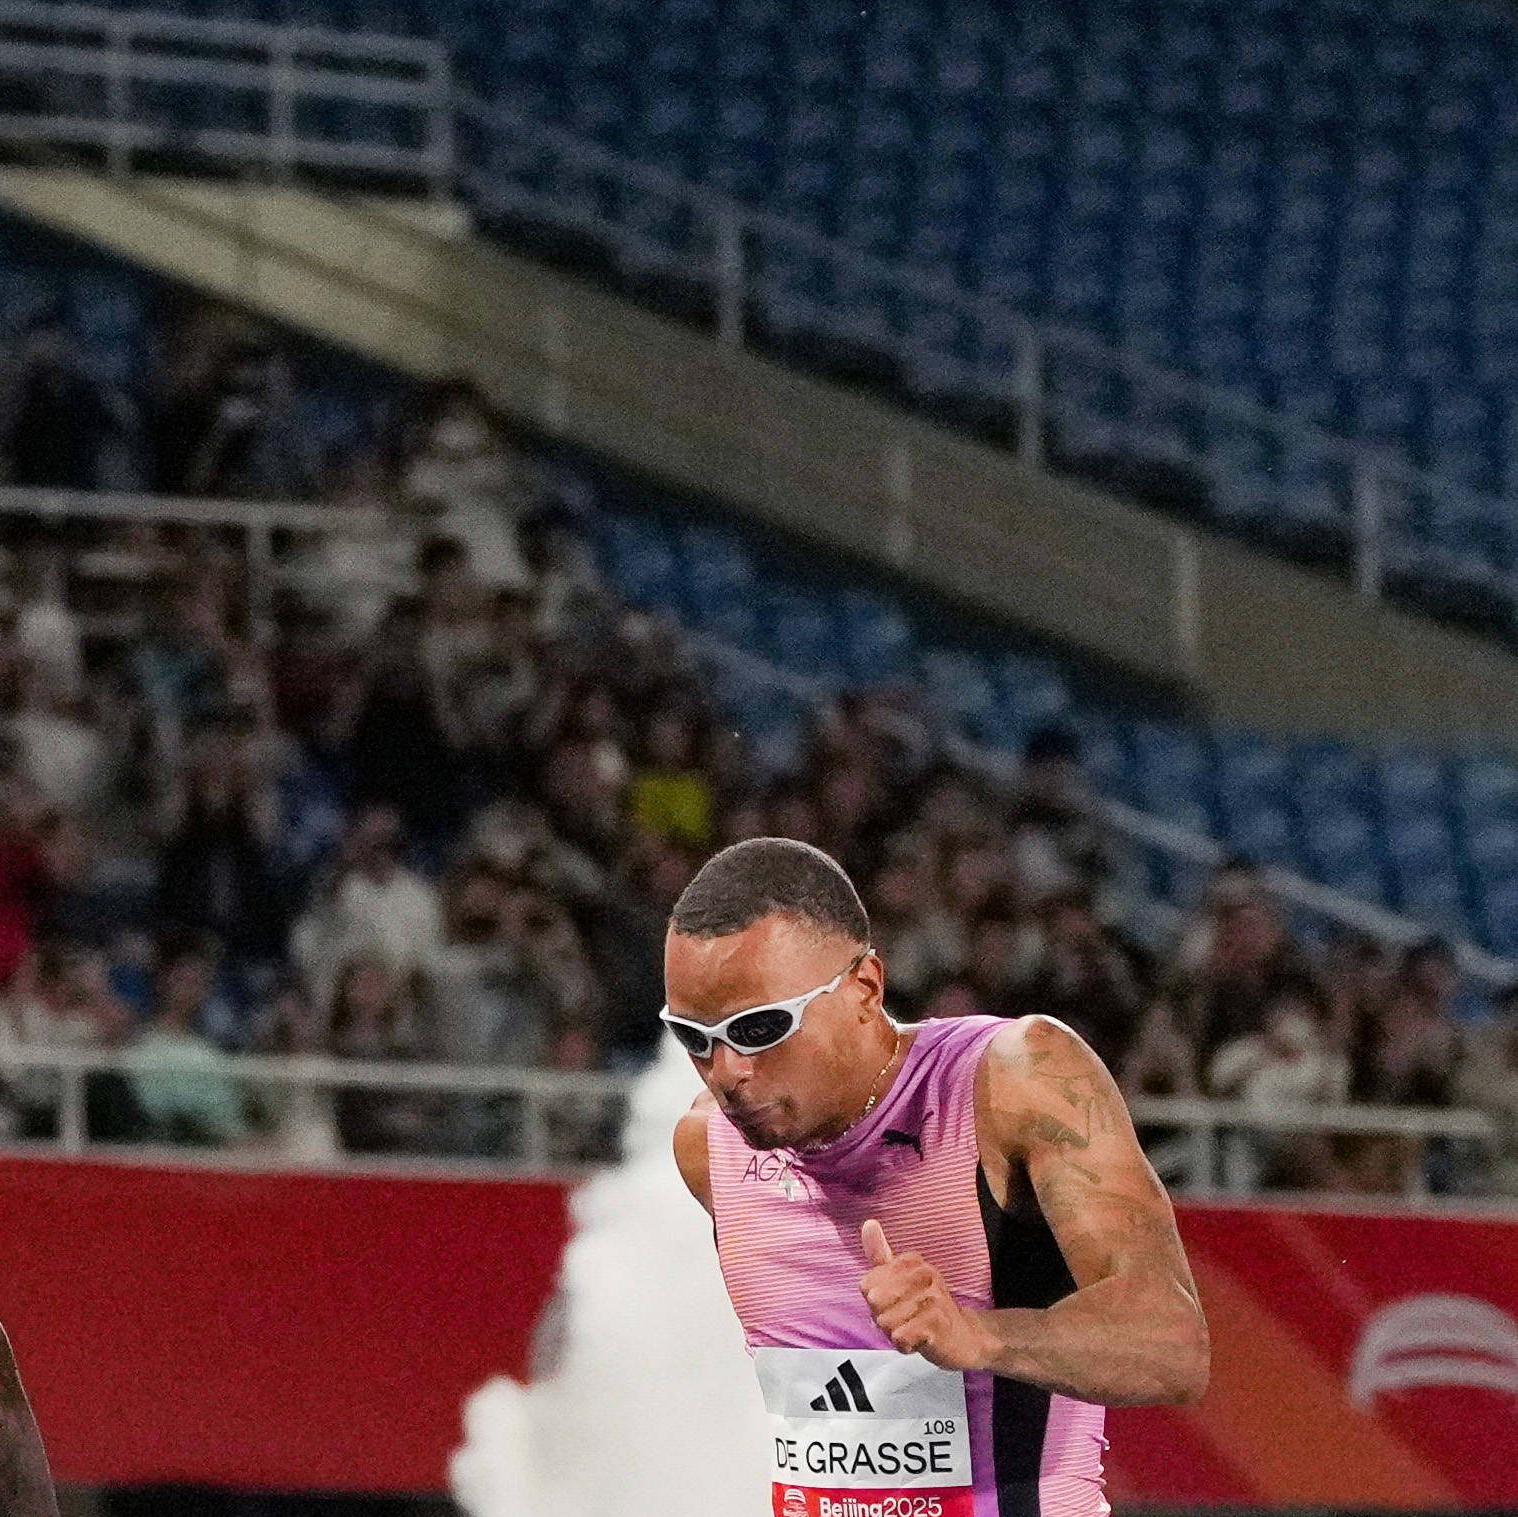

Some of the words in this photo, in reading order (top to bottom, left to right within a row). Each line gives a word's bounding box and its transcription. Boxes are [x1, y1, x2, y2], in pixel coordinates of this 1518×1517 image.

[924, 1420, 955, 1435] 108
[775, 1437, 799, 1472] DE
[806, 1440, 953, 1475] GRASSE
